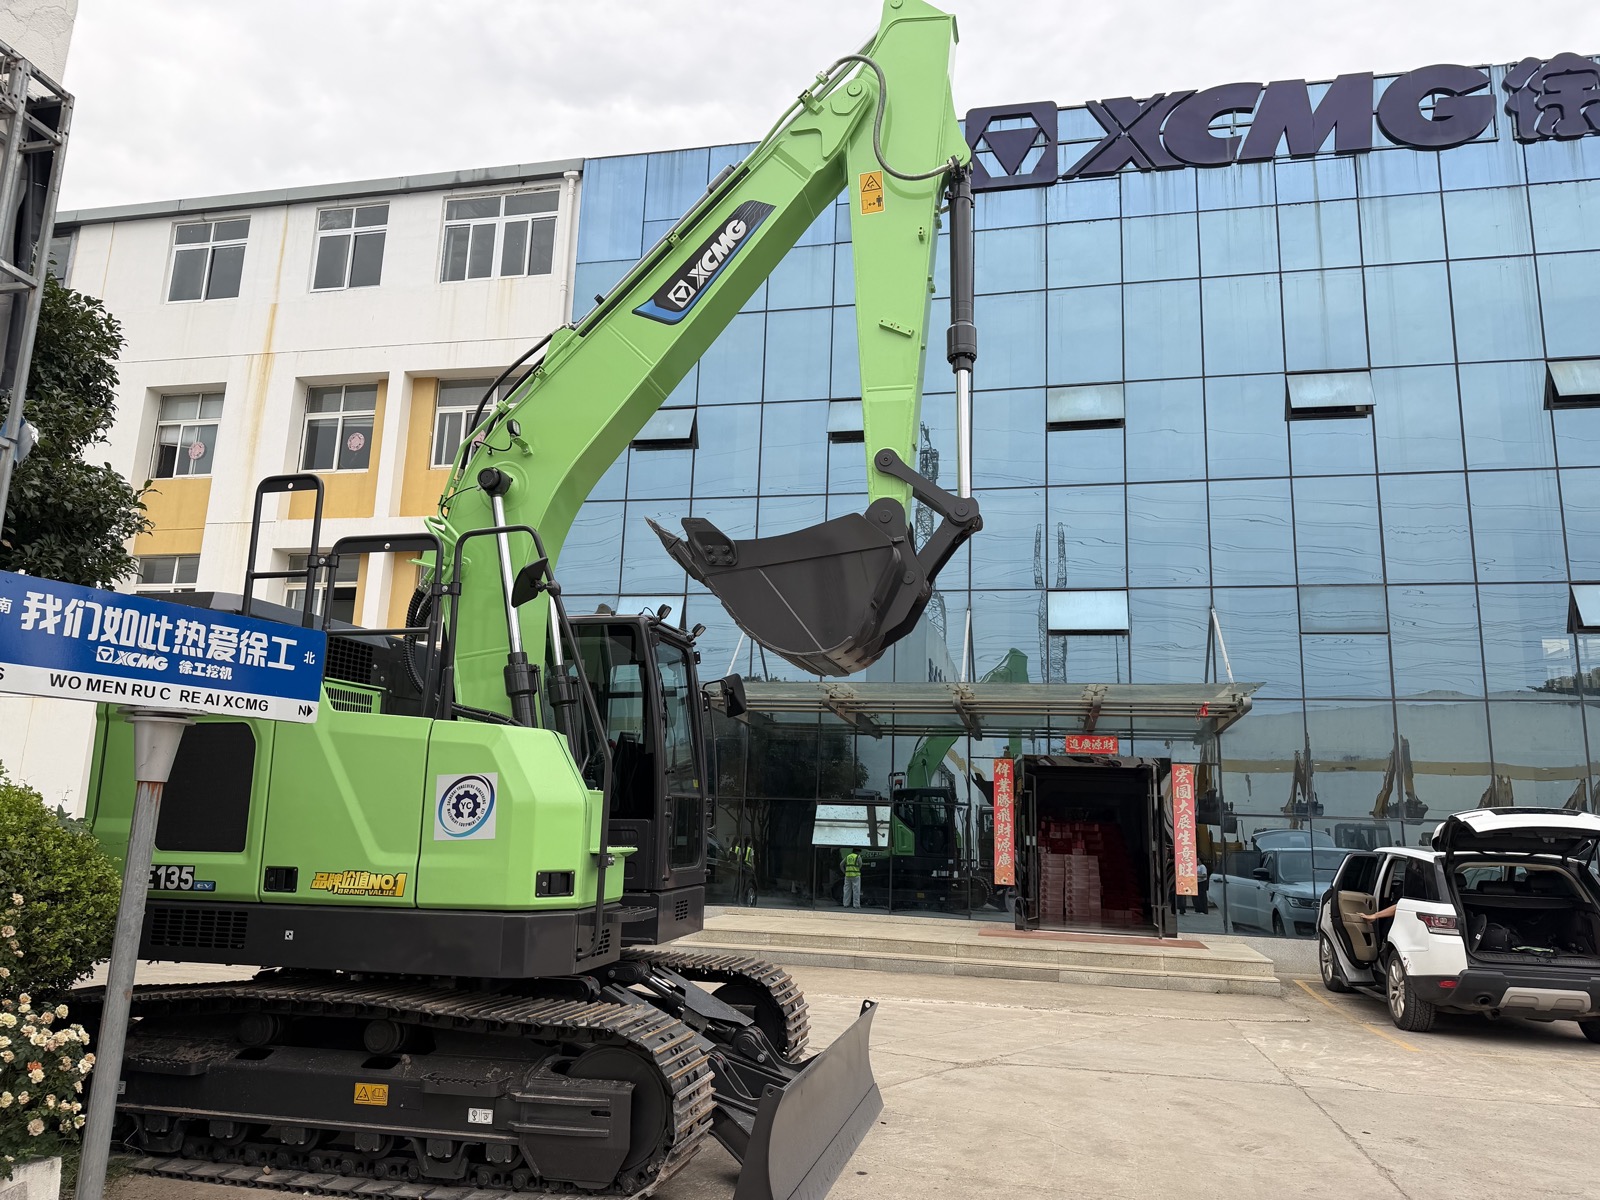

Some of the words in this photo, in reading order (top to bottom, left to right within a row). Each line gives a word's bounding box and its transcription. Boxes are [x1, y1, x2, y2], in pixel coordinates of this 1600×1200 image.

[1062, 64, 1498, 180] XCMG
[1502, 52, 1600, 144] 徐
[687, 219, 747, 290] XCMG
[21, 591, 298, 672] 我们如此热爱徐工
[112, 650, 169, 671] XCMG
[303, 650, 316, 666] 北
[178, 660, 233, 681] 徐工挖机
[298, 705, 307, 716] N
[461, 801, 472, 810] YC
